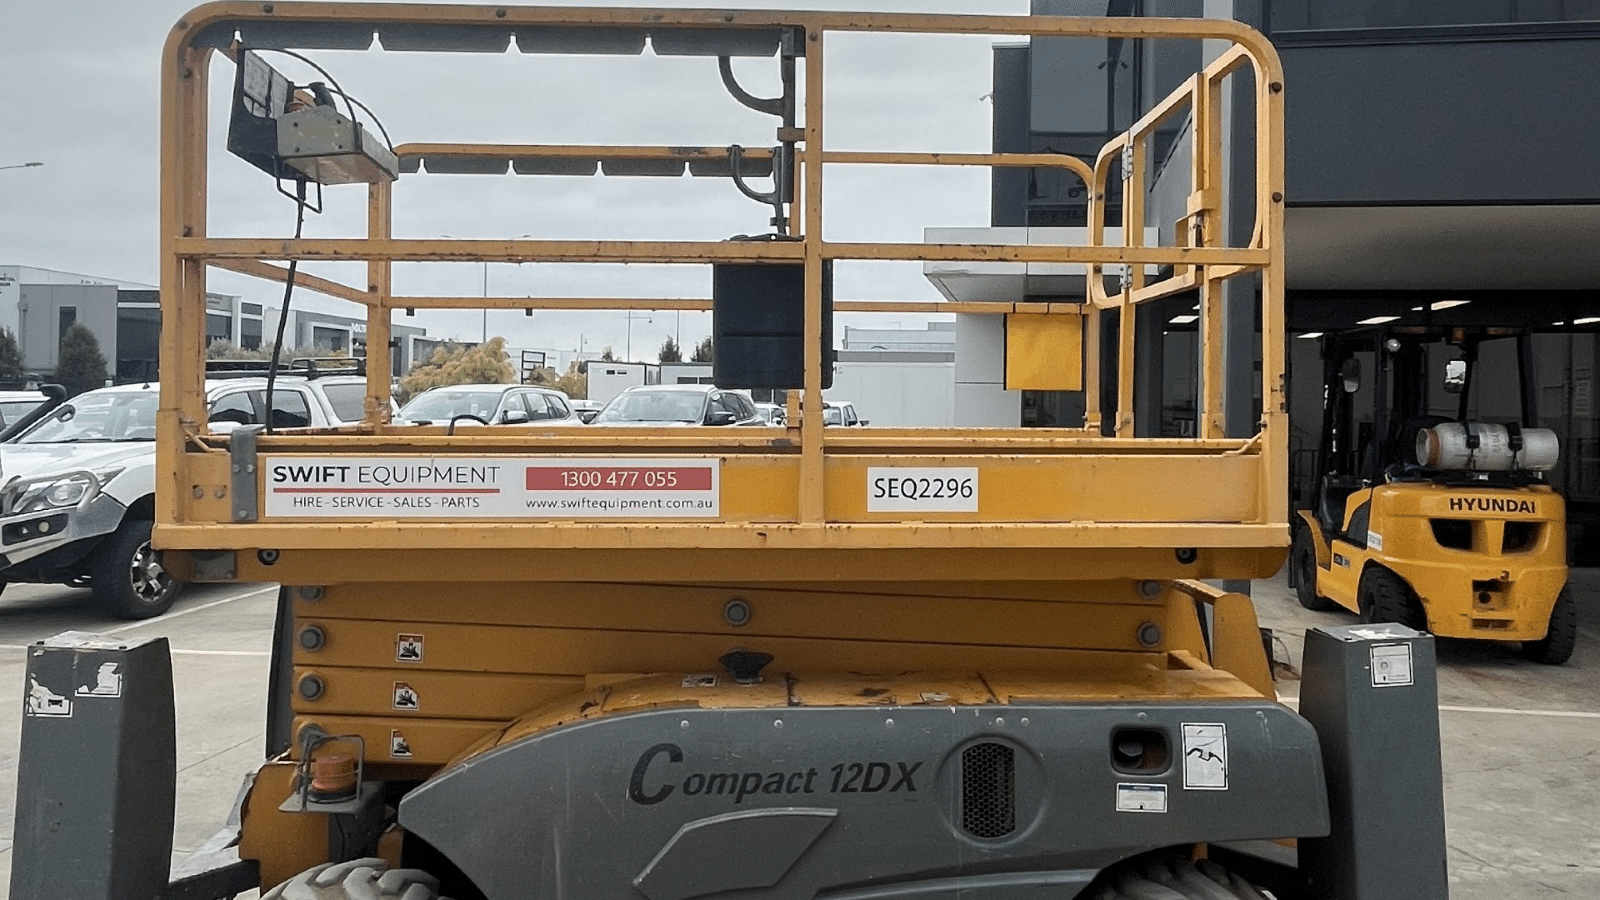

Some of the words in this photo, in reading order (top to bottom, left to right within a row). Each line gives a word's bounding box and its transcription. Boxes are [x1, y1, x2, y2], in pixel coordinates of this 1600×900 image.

[273, 465, 351, 483] SWIFT
[358, 465, 501, 486] EQUIPMENT
[560, 470, 602, 487] 1300
[606, 470, 639, 487] 477
[644, 470, 678, 487] 055
[873, 477, 973, 501] SEQ2296
[293, 496, 323, 508] HIRE
[332, 496, 384, 508] SERVICE
[393, 496, 432, 508] SALES
[441, 496, 480, 508] PARTS
[525, 497, 713, 511] www.swiftequipment.com.au
[1450, 497, 1536, 514] HYUNDAI
[629, 743, 818, 805] Compact
[829, 761, 924, 793] 12DX
